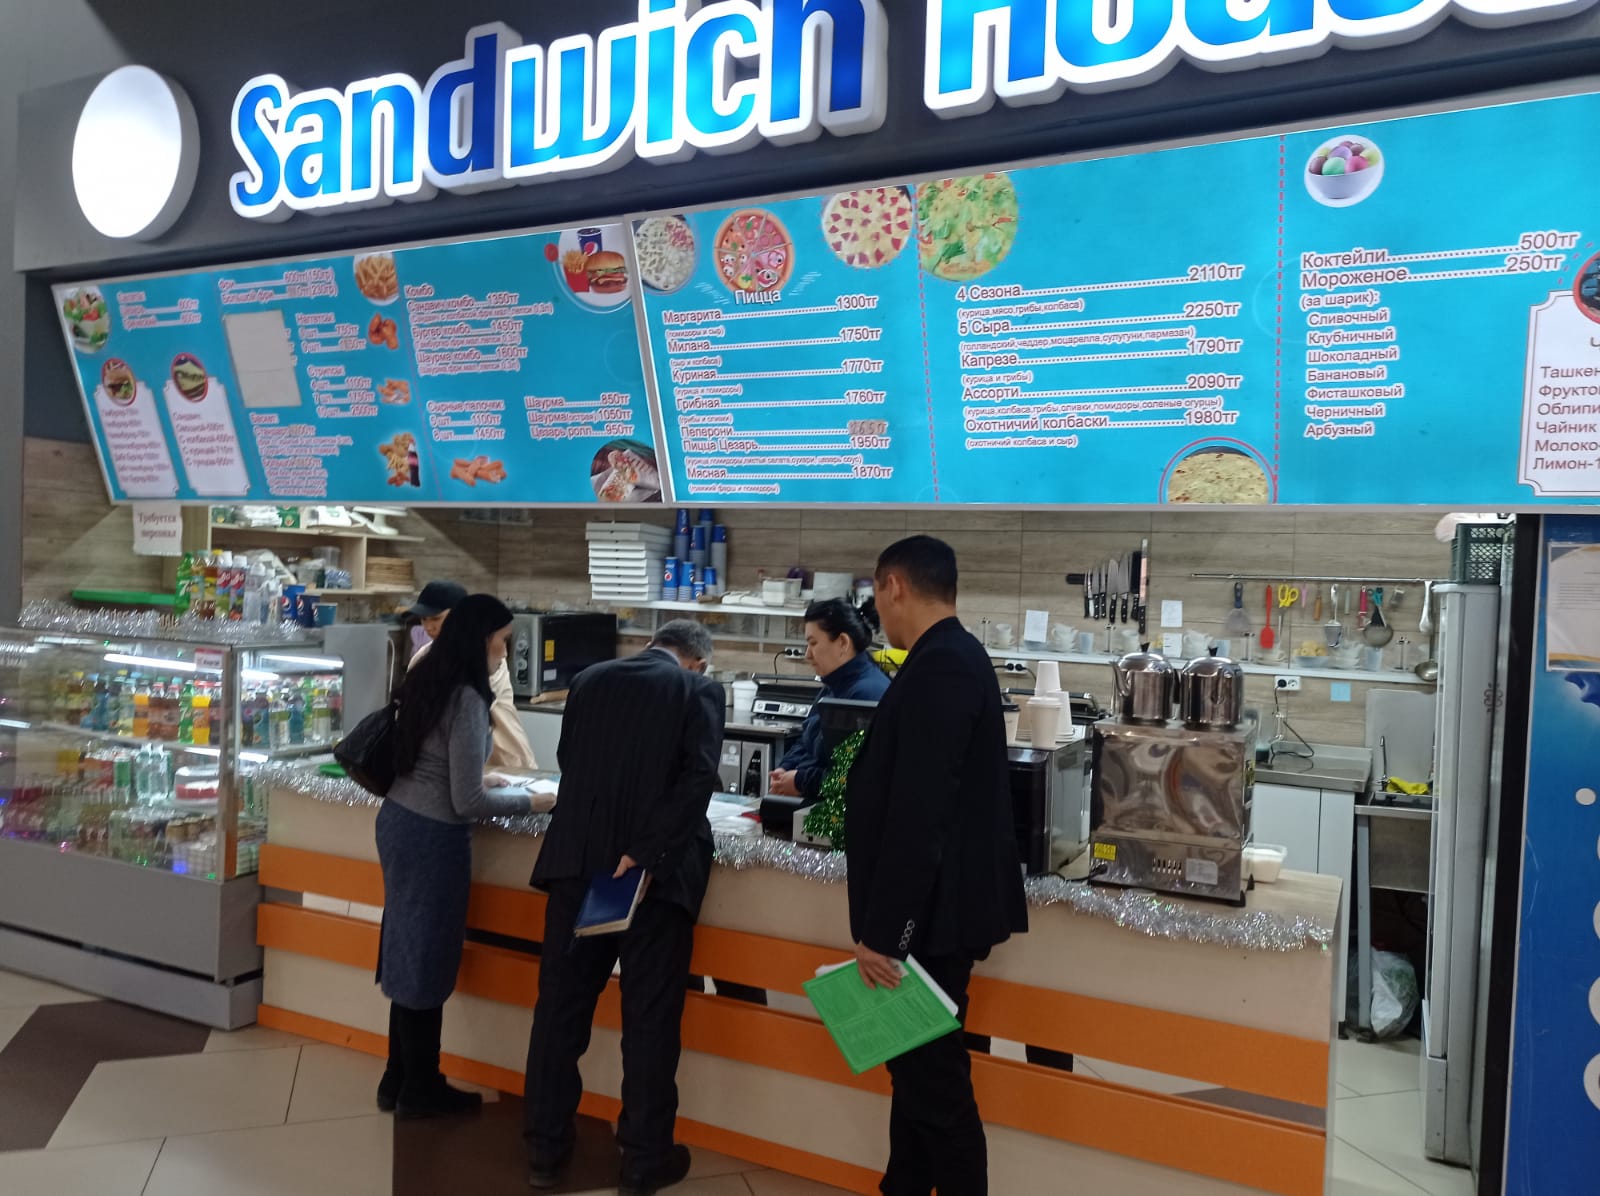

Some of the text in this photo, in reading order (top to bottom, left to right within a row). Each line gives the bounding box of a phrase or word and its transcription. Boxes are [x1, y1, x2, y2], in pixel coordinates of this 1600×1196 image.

[232, 0, 868, 212] Sandwich
[1303, 232, 1578, 269] Коктейли 500тг
[1302, 254, 1563, 288] Мороженое 250тг
[404, 284, 434, 297] Комбо
[957, 265, 1243, 300] 4 Сезона 2110тг
[735, 290, 781, 304] Пицца
[1302, 292, 1379, 308] (за шарик):
[664, 295, 878, 324] Маргарита 1300тг
[1309, 310, 1388, 325] Сливочный
[960, 303, 1239, 335] 5 Сыра 2250тг
[668, 328, 881, 352] Милана 1750тг
[1309, 329, 1394, 346] Клубничный
[962, 339, 1241, 369] Капрезе 1790тг
[1308, 348, 1397, 364] Шоколадный
[672, 360, 883, 383] Куриная 1770тг
[1308, 367, 1385, 381] Банановый
[963, 375, 1241, 400] Ассорти 2090тг
[1307, 386, 1402, 400] Фисташковый
[1538, 384, 1600, 399] Фрукто
[526, 394, 629, 410] Шаурма 850тг
[676, 391, 885, 411] Грибная 1760тг
[966, 410, 1238, 431] Охотничий колбаски 1980тг
[1307, 405, 1384, 420] Черничный
[681, 427, 734, 439] Пеперони
[1305, 423, 1373, 438] Арбузный
[1536, 419, 1598, 434] Чайник
[683, 435, 890, 452] Пицца Цезарь 1950тг
[688, 466, 892, 479] Мясная 1870тг
